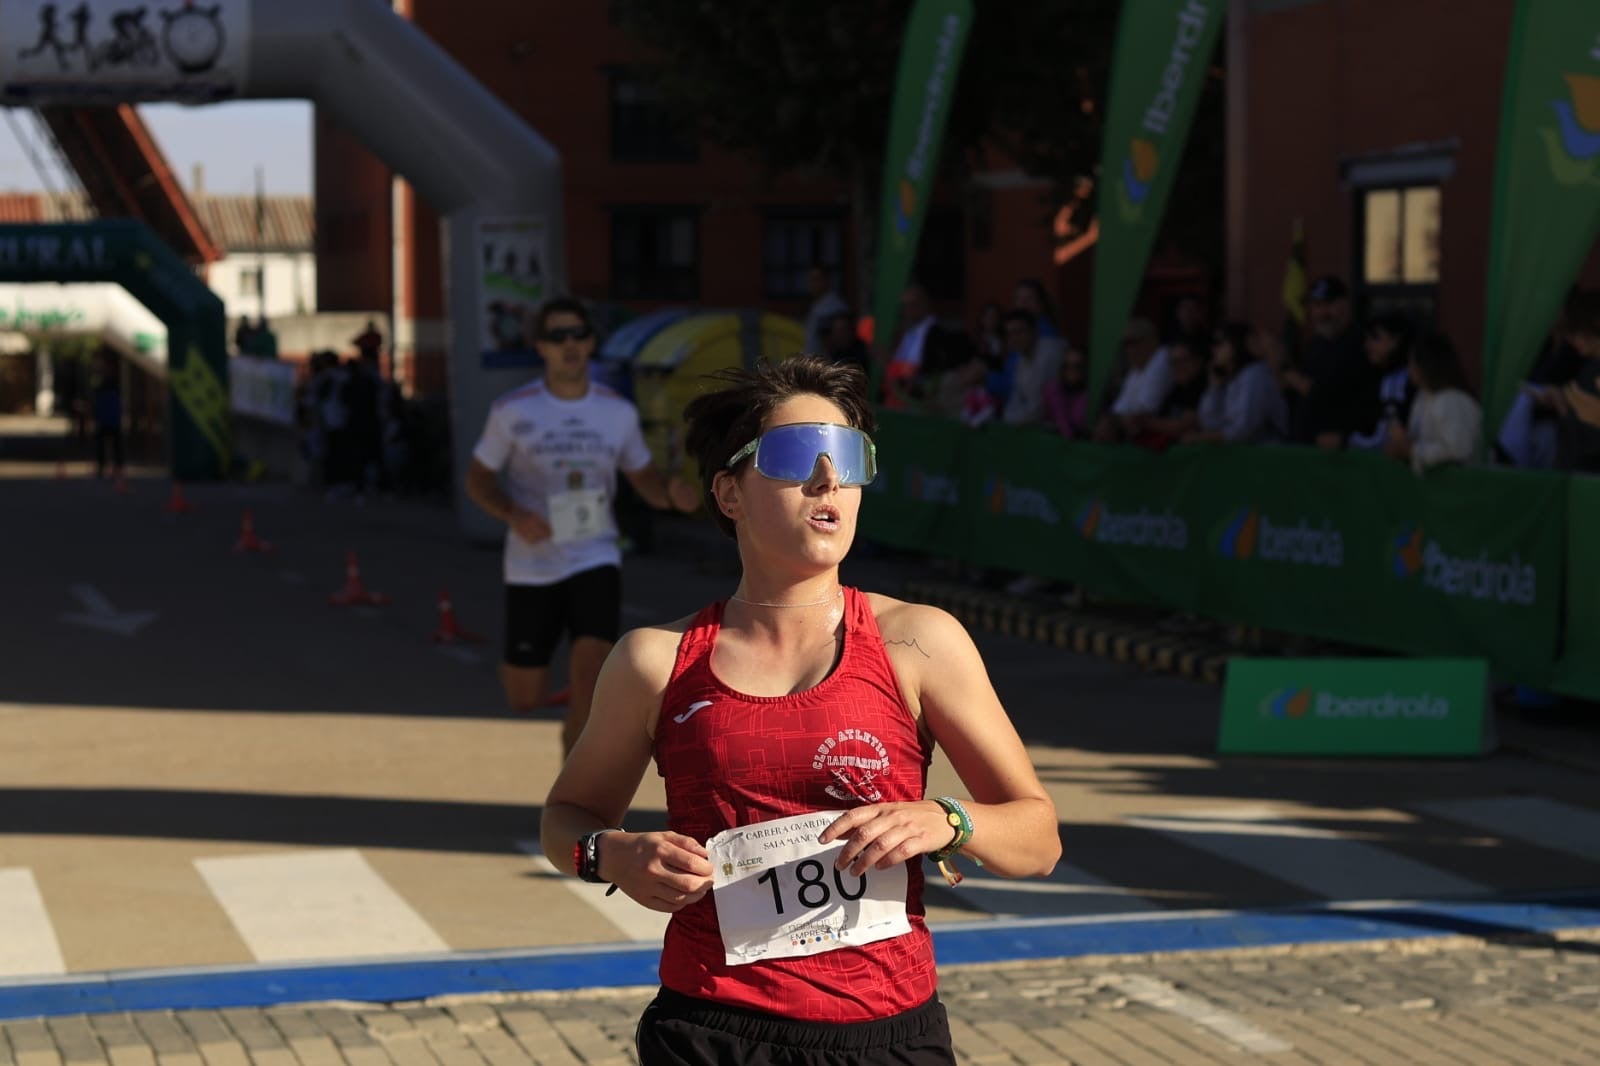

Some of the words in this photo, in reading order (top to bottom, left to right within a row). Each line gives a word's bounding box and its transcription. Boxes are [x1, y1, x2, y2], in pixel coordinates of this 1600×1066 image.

[1422, 538, 1537, 606] Iberdrola
[1315, 690, 1449, 721] Iberdrola
[812, 737, 837, 770] CLUB
[745, 825, 789, 841] CARRERA
[758, 859, 868, 915] 180
